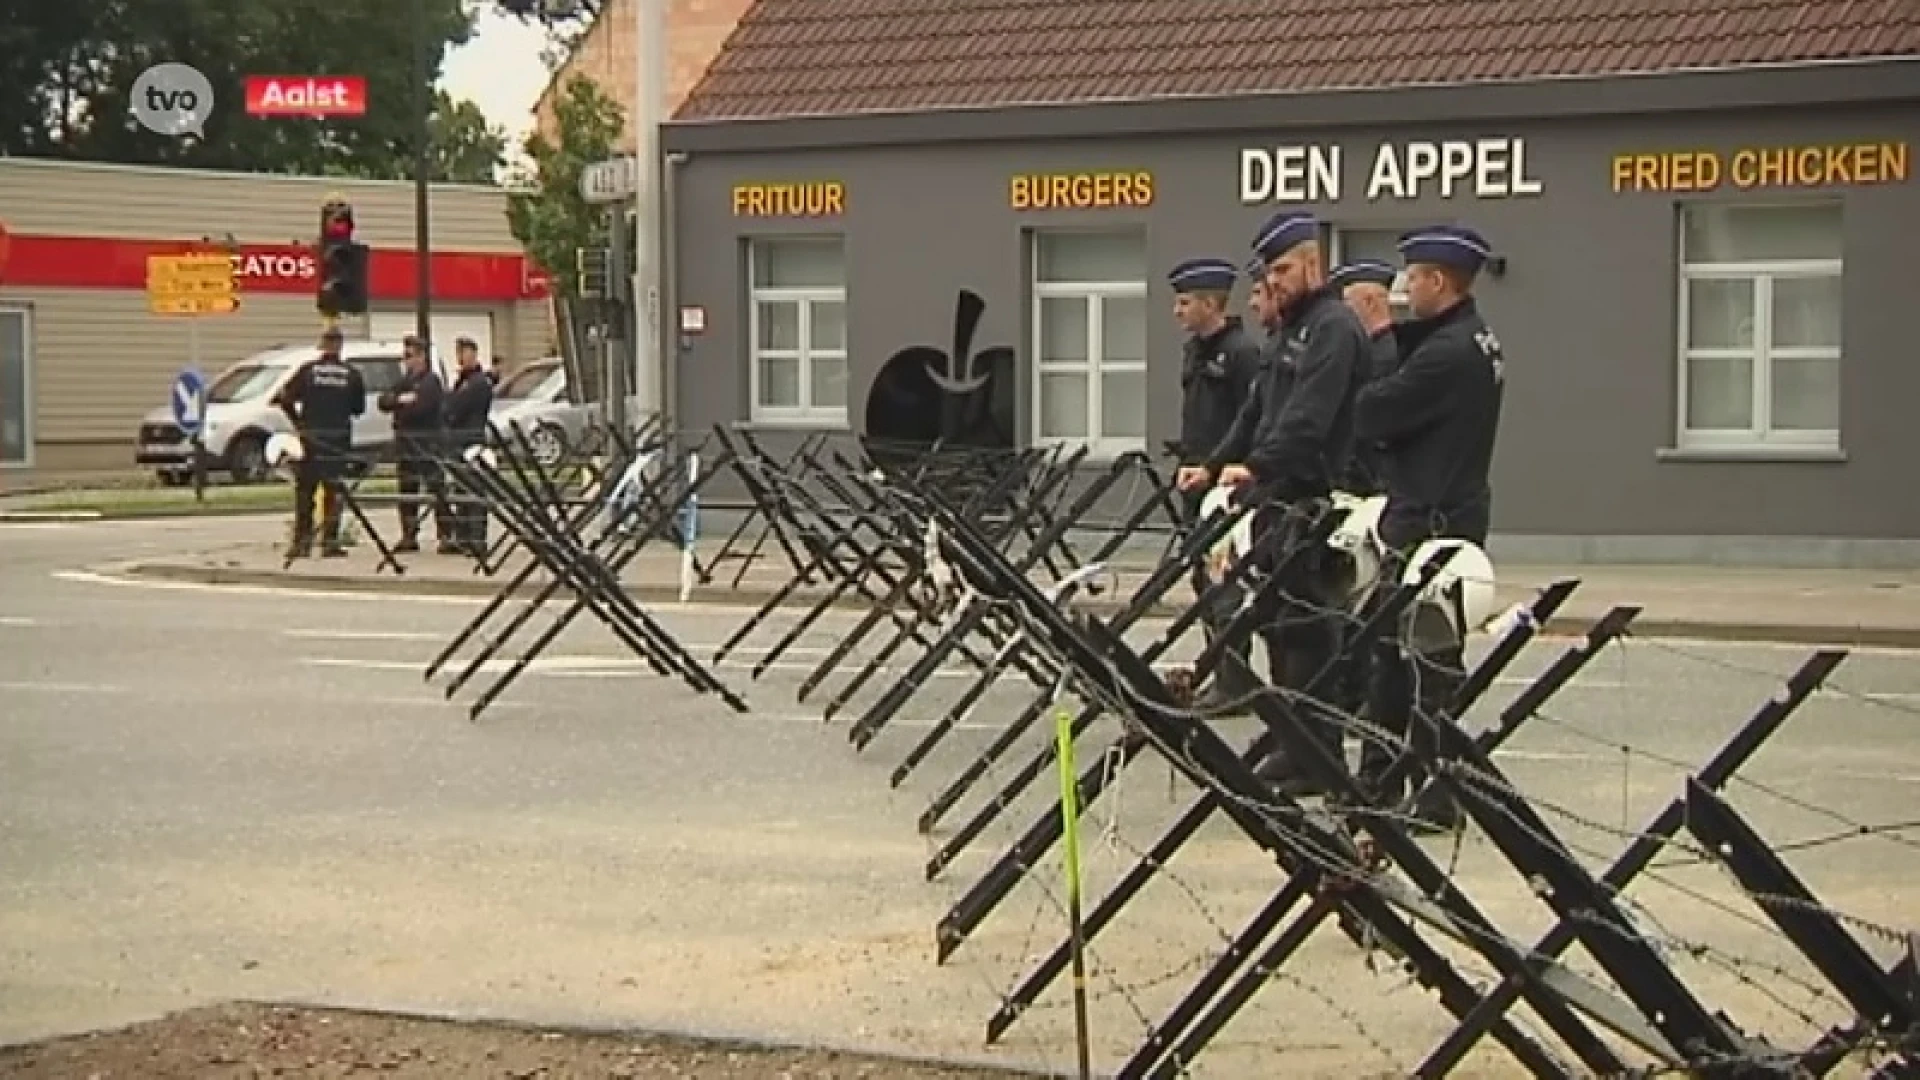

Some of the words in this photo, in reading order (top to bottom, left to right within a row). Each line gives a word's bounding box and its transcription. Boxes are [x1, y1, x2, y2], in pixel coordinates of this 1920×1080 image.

[1011, 171, 1152, 209] BURGERS
[1241, 146, 1341, 201] DEN
[1367, 138, 1542, 198] APPEL
[1612, 153, 1720, 193] FRIED
[1731, 143, 1907, 187] CHICKEN
[733, 183, 844, 217] FRITUUR
